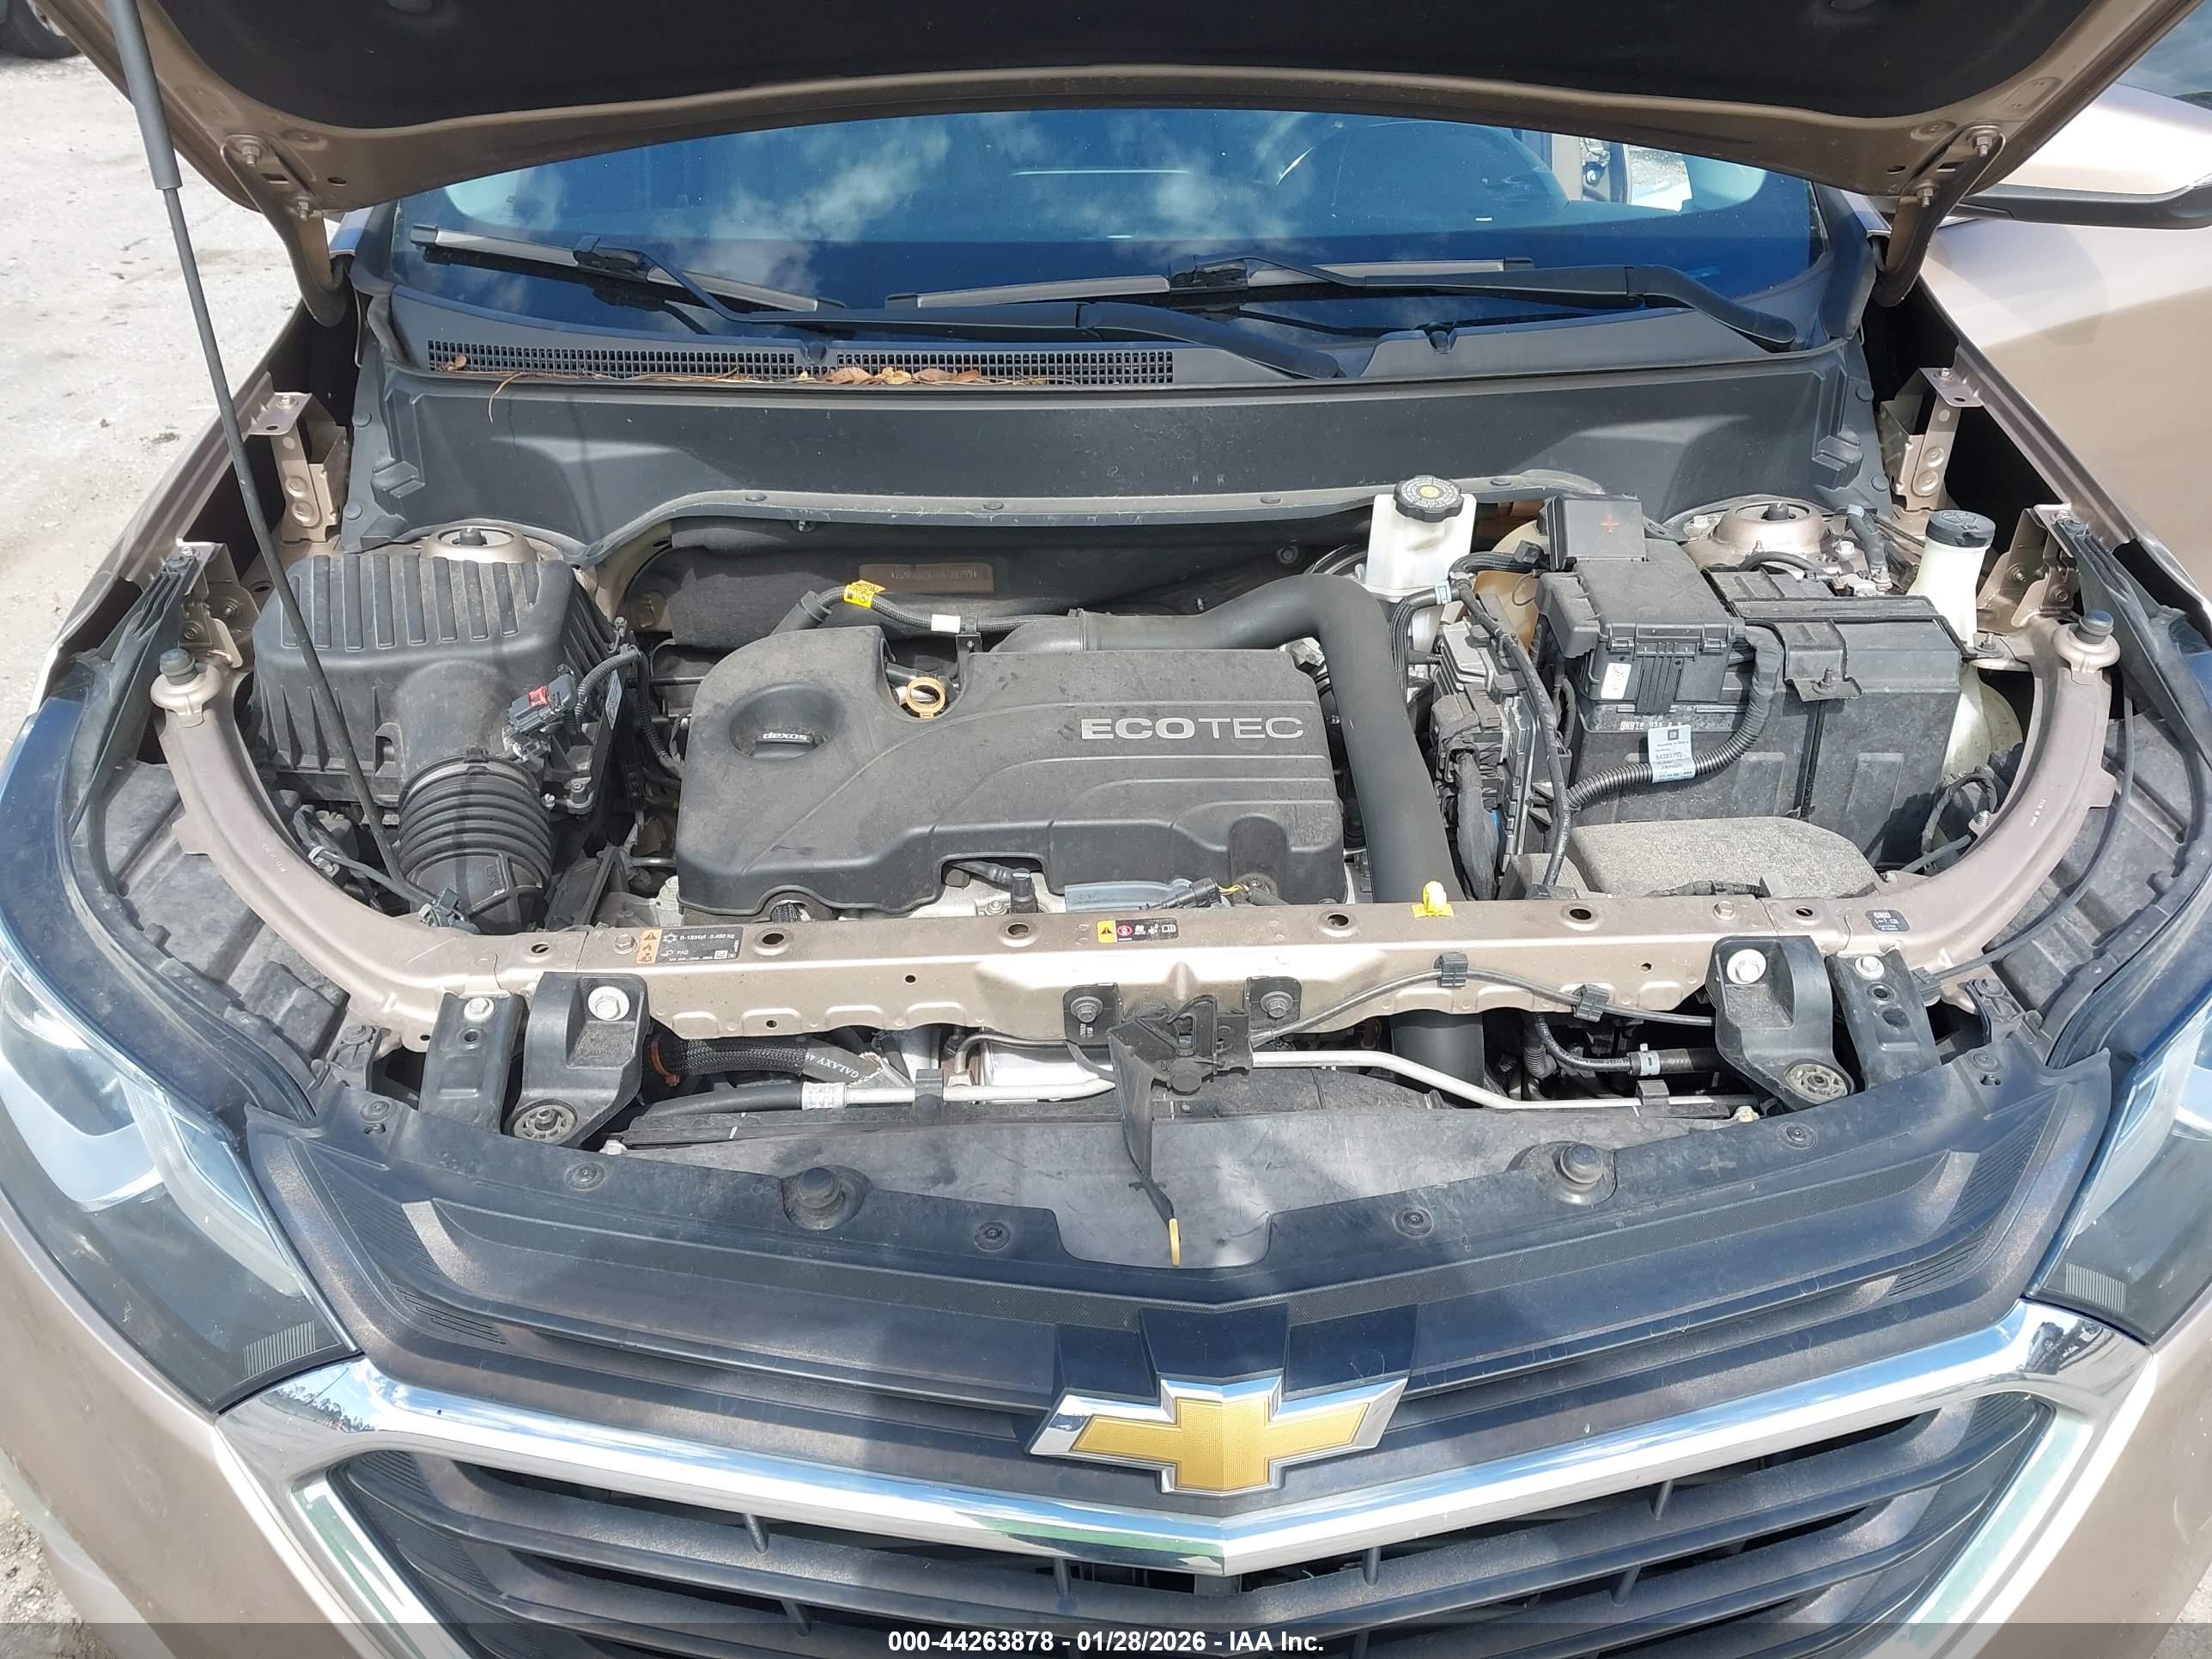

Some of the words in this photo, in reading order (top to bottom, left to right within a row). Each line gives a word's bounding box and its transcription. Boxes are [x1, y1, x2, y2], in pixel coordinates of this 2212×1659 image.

[763, 732, 808, 740] dexos
[1080, 717, 1304, 739] ECOTEC
[817, 1057, 860, 1079] GALAXY
